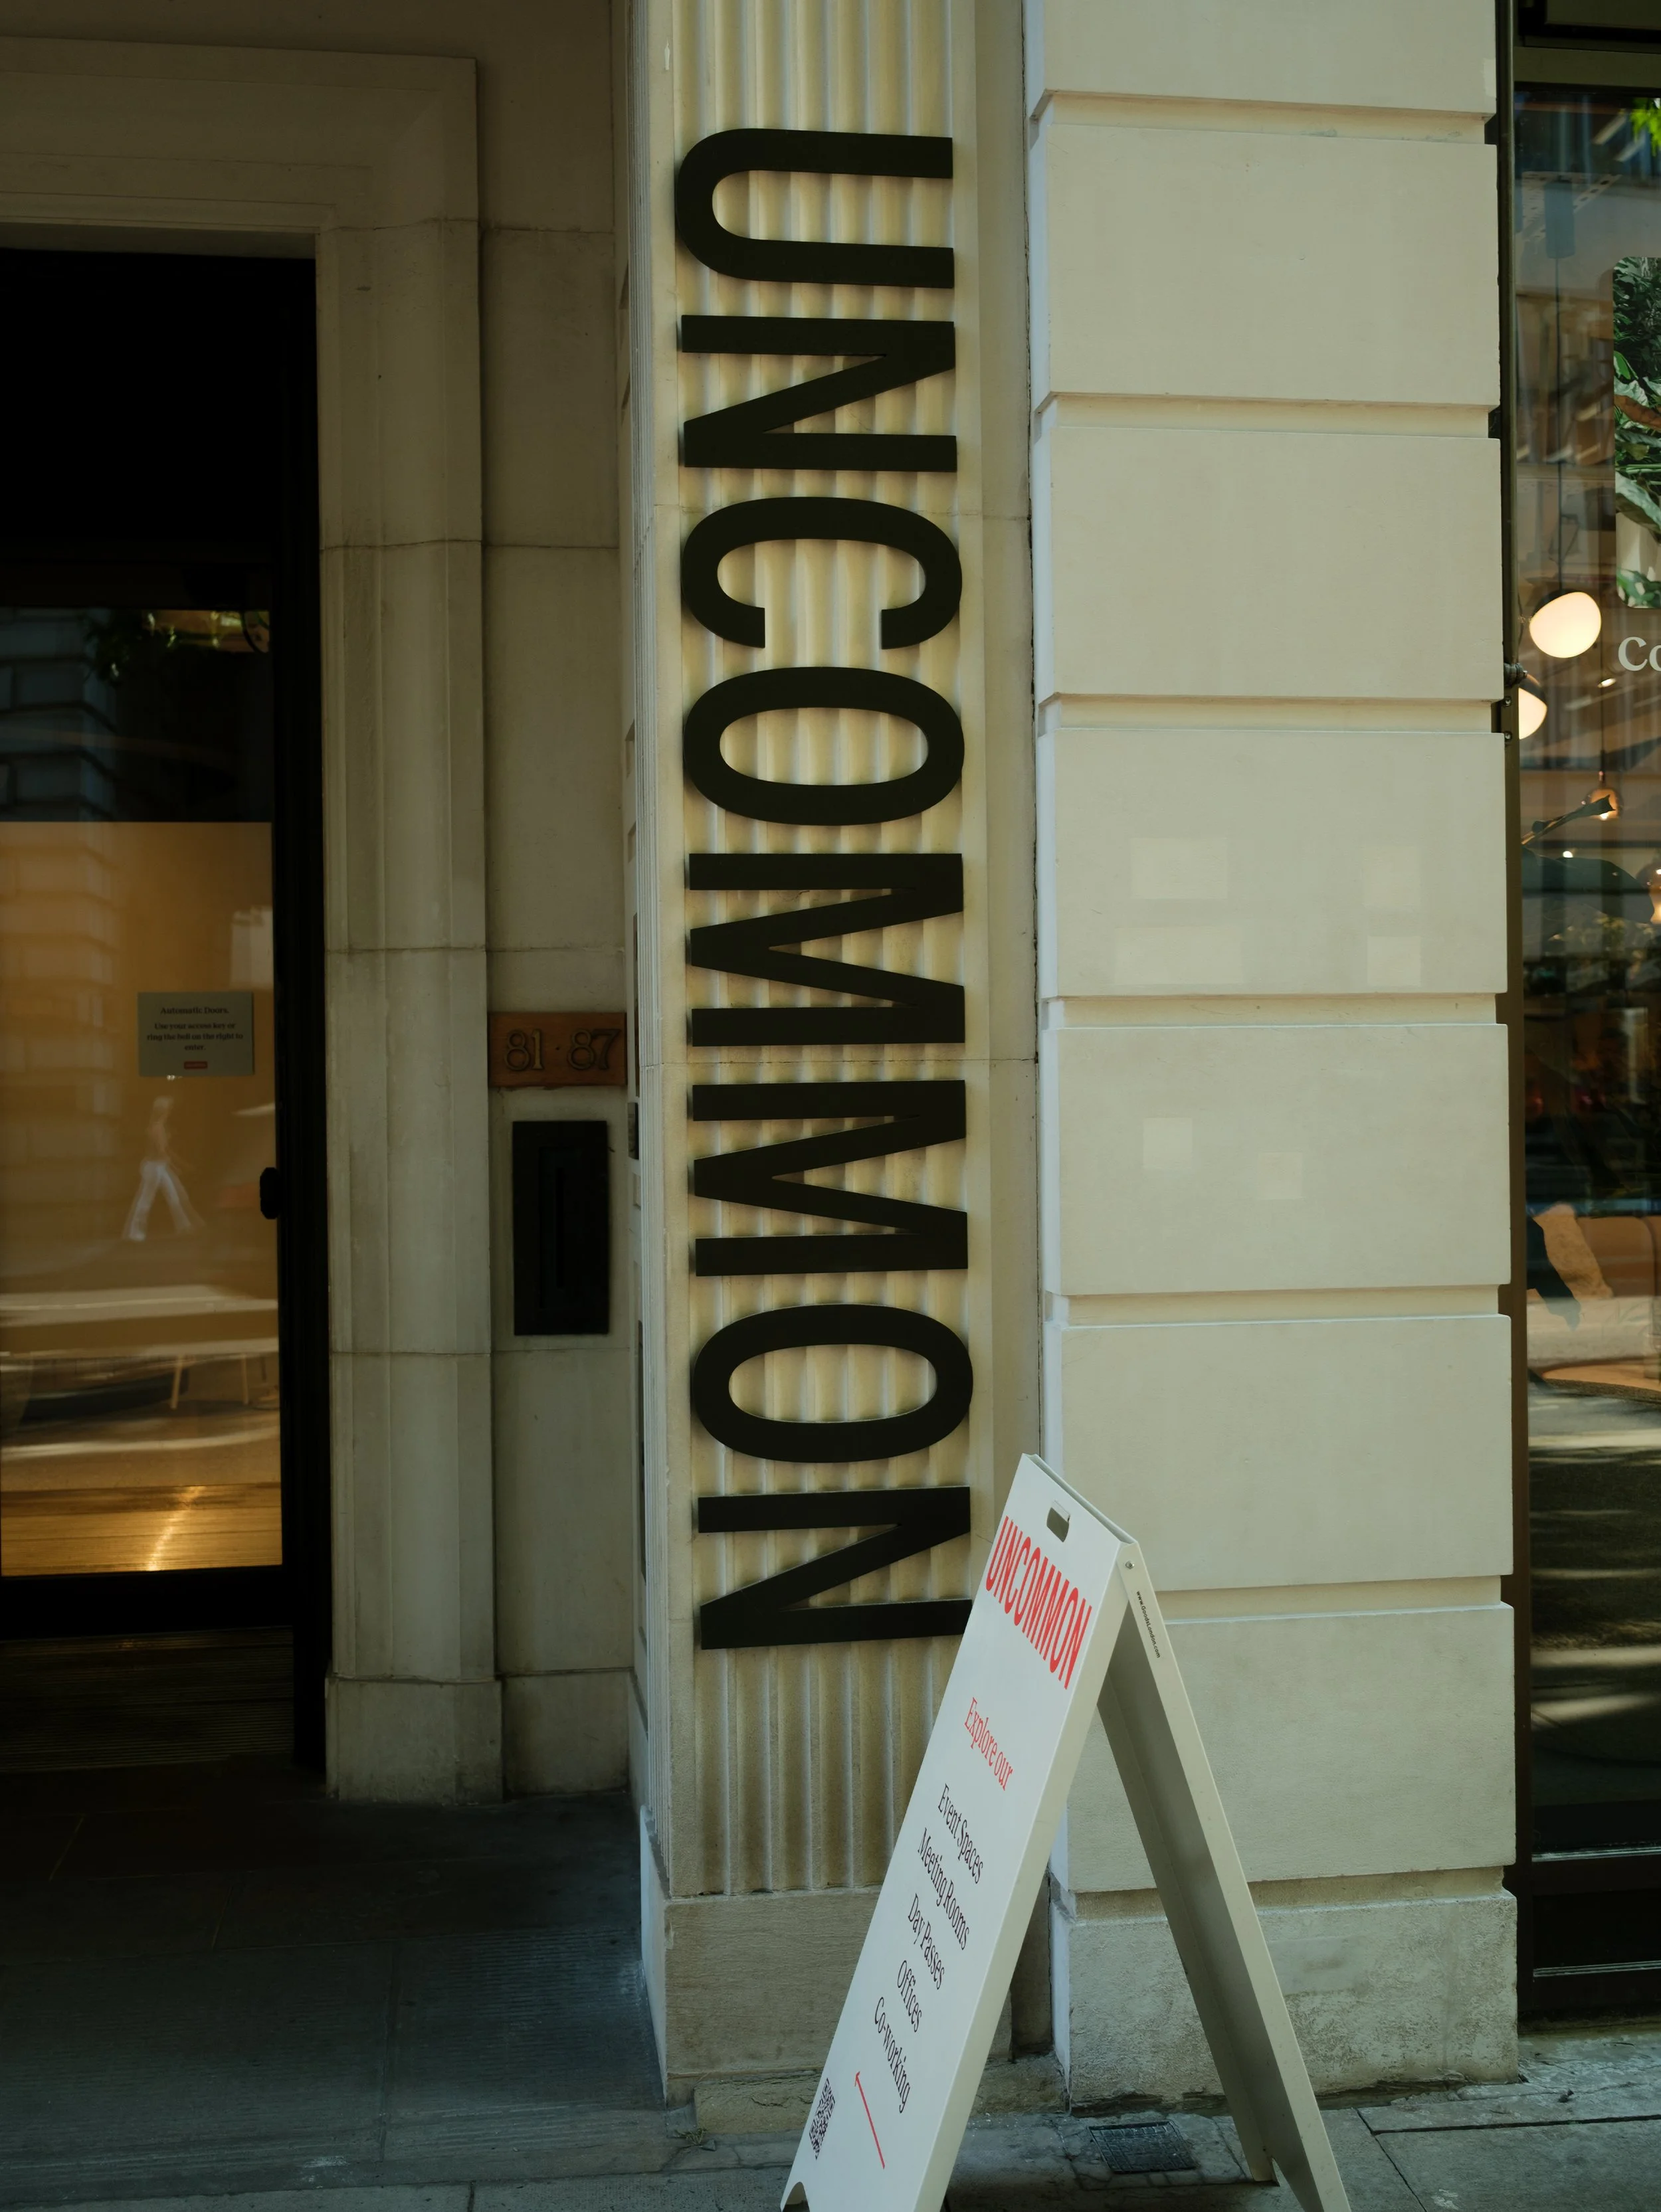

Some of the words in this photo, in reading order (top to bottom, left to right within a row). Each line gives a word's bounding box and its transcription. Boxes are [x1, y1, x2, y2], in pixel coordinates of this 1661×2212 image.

[676, 128, 974, 1649] UNCOMMON
[216, 1033, 235, 1042] right
[504, 1029, 543, 1071] 81
[567, 1029, 621, 1070] 87
[985, 1515, 1093, 1690] UNCOMMON
[1136, 1590, 1161, 1659] www.GoodsLondon.com
[964, 1697, 998, 1767] Explore
[994, 1751, 1014, 1792] our
[937, 1782, 963, 1839] Event
[957, 1819, 983, 1885] Spaces
[917, 1827, 947, 1907] Meeting
[943, 1879, 970, 1951] Rooms
[908, 1892, 926, 1945] Day
[920, 1920, 945, 1990] Passes
[897, 1960, 922, 2033] Offices
[874, 1996, 911, 2114] Co-working
